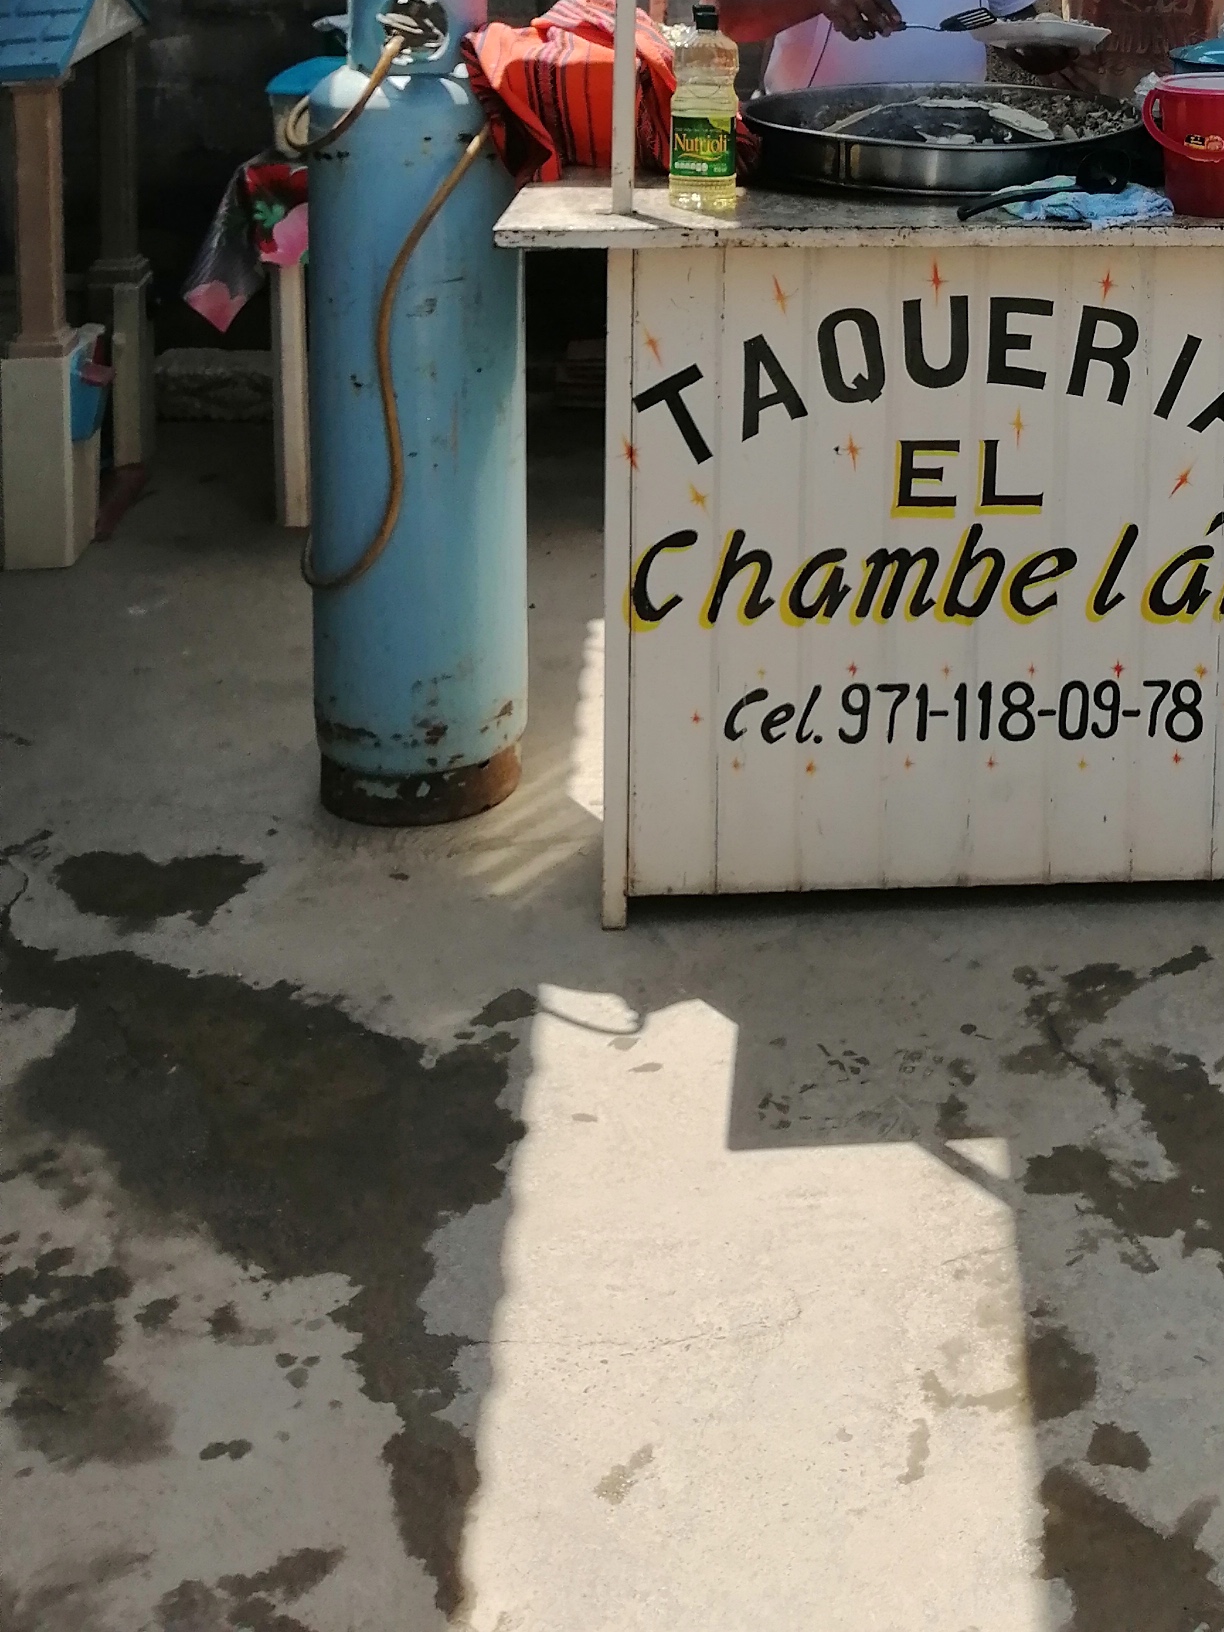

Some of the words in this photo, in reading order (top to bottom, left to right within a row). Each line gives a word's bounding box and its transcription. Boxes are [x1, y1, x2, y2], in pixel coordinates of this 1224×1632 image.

[674, 134, 728, 153] Nutrioli
[891, 438, 1045, 519] EL
[837, 679, 1205, 746] 971-118-09-78
